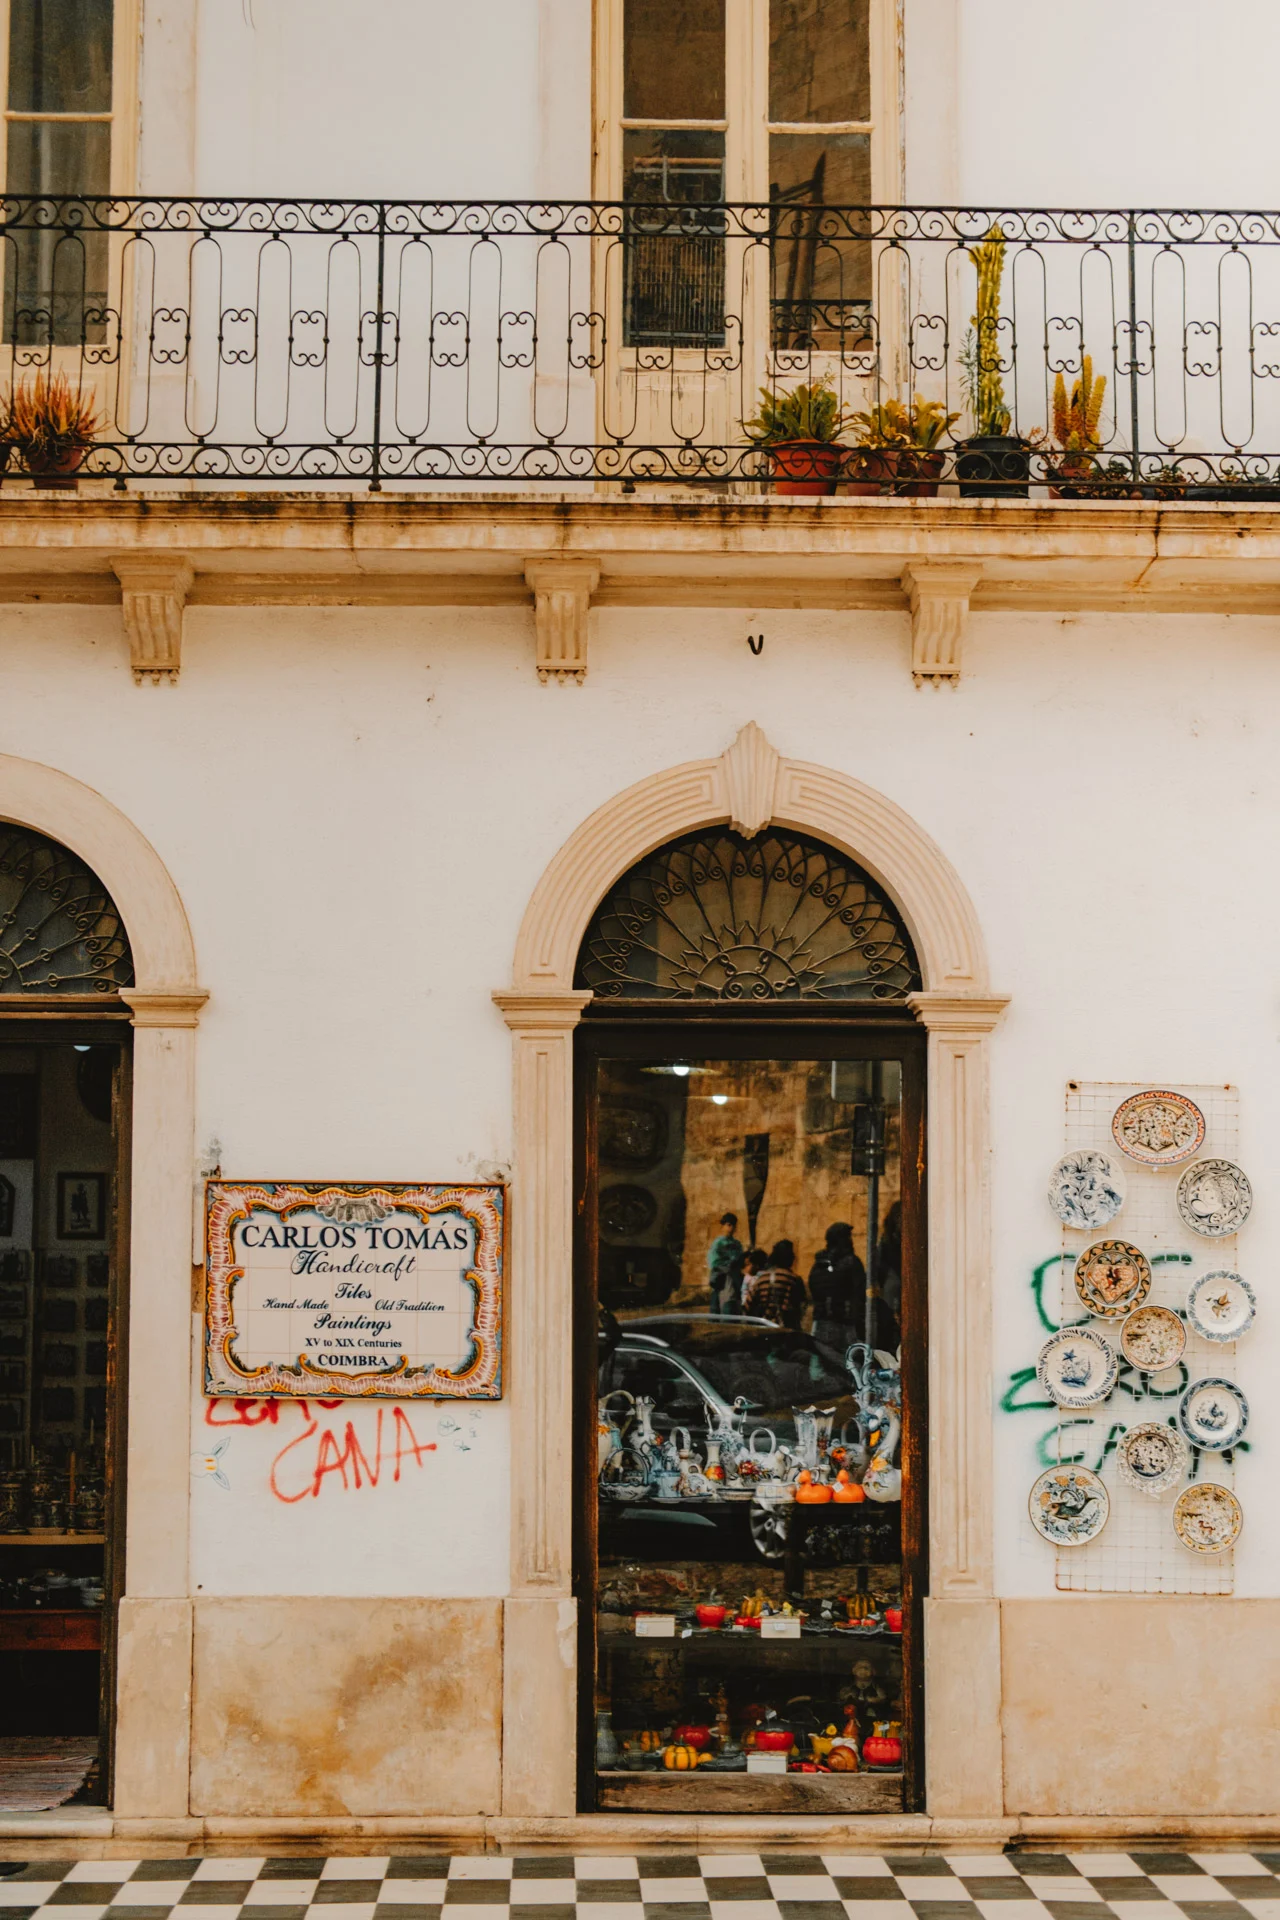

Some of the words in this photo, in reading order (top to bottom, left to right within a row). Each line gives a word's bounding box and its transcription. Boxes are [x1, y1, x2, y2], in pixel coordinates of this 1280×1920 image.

[241, 1225, 356, 1249] CARLOS
[365, 1221, 468, 1250] TOMÁS
[291, 1249, 417, 1281] Handicraft
[335, 1282, 372, 1299] Tiles
[262, 1298, 297, 1309] Hand
[297, 1298, 329, 1310] Made
[375, 1299, 395, 1311] Old
[396, 1299, 445, 1312] Tradition
[314, 1312, 392, 1336] Paintings
[305, 1337, 320, 1347] XV
[323, 1338, 333, 1347] to
[335, 1338, 355, 1348] XIX
[357, 1338, 402, 1348] Centuries
[318, 1354, 389, 1367] COIMBRA
[270, 1406, 438, 1504] CANA
